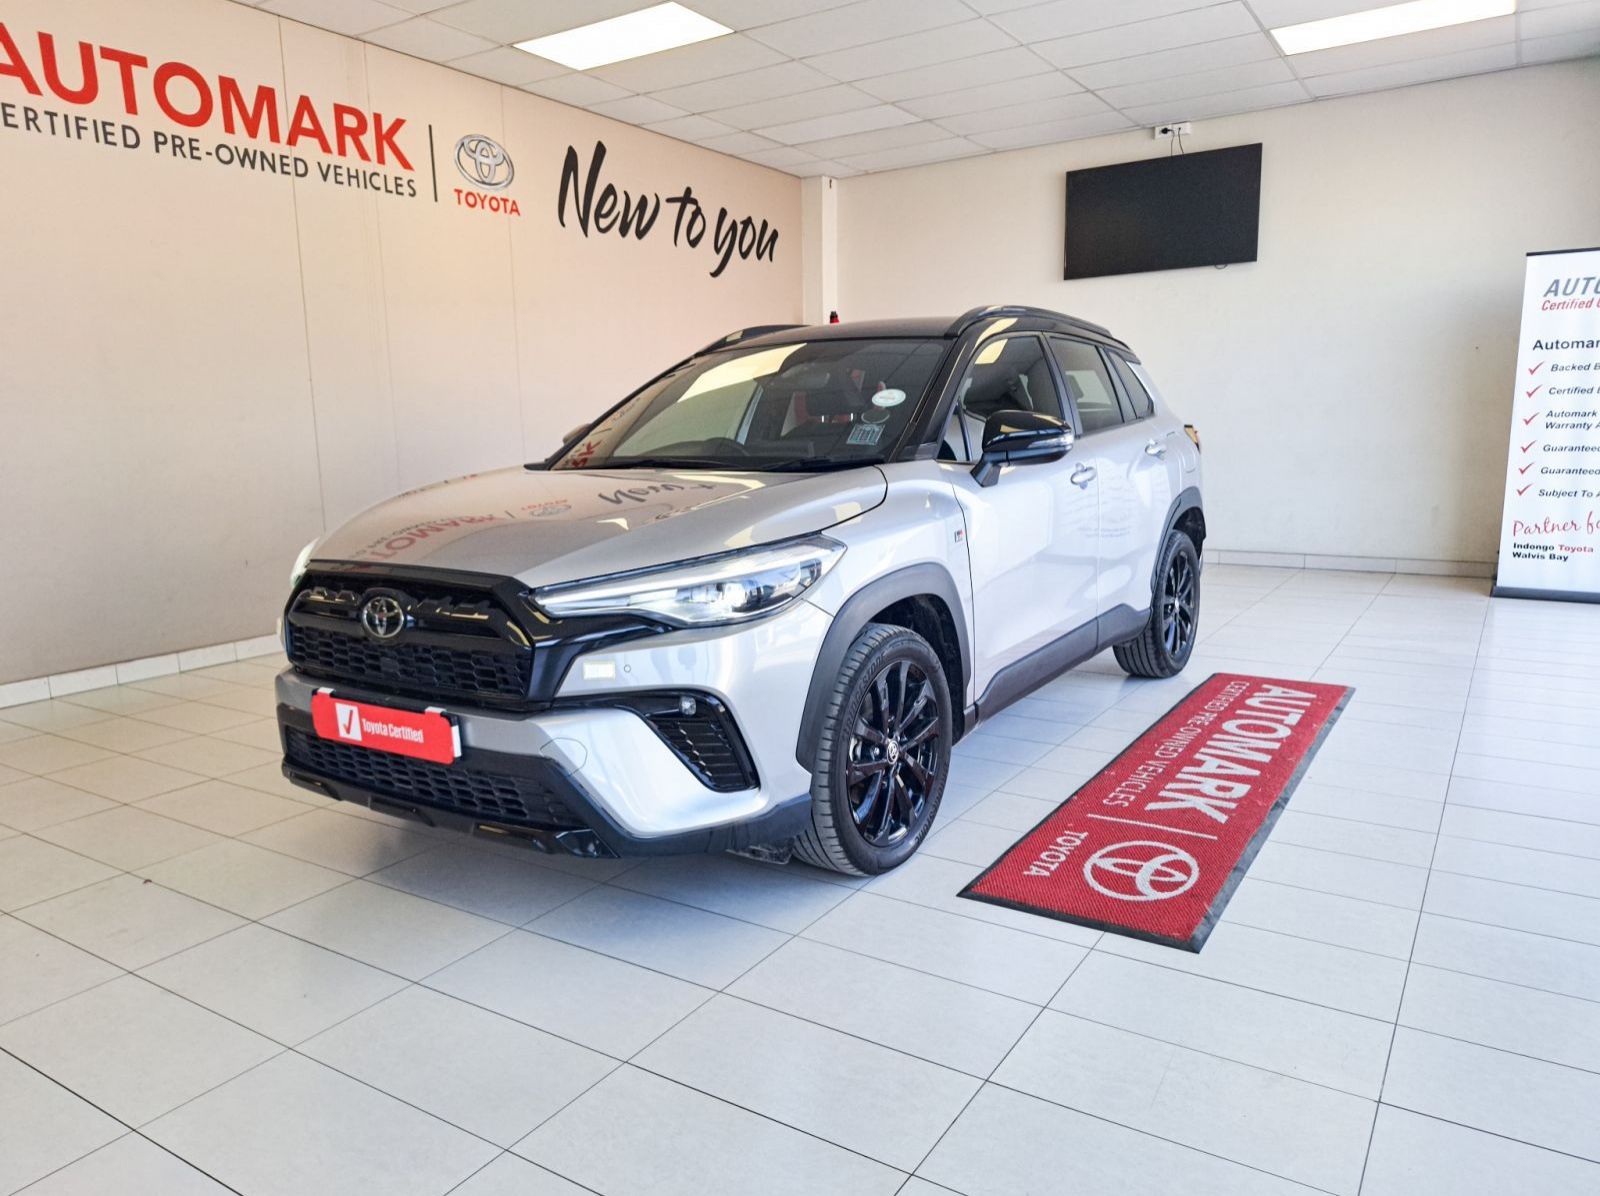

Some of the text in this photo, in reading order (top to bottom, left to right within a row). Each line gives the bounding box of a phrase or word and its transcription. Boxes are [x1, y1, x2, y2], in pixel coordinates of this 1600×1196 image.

[0, 22, 415, 171] AUTOMARK
[1, 102, 416, 198] ERTIFIED PRE-OWNED VEHICLES
[454, 188, 521, 217] TOYOTA
[557, 140, 779, 278] New to you
[1541, 297, 1595, 311] Certified
[1550, 363, 1591, 373] Backed
[1548, 386, 1594, 395] Certified
[1546, 410, 1597, 418] Automark
[1545, 421, 1593, 431] Warranty
[1538, 488, 1578, 499] Subject
[1581, 489, 1593, 498] To
[1512, 515, 1582, 537] Partner
[1512, 551, 1569, 562] Walvis Bay
[1513, 542, 1594, 554] Indongo Toyota
[361, 717, 425, 744] Toyota Certified
[1102, 680, 1251, 808] CERTIFIED PRE-OWNED VEHICLES
[1144, 683, 1318, 825] AUTOMARK
[1023, 829, 1089, 878] TOYOTA
